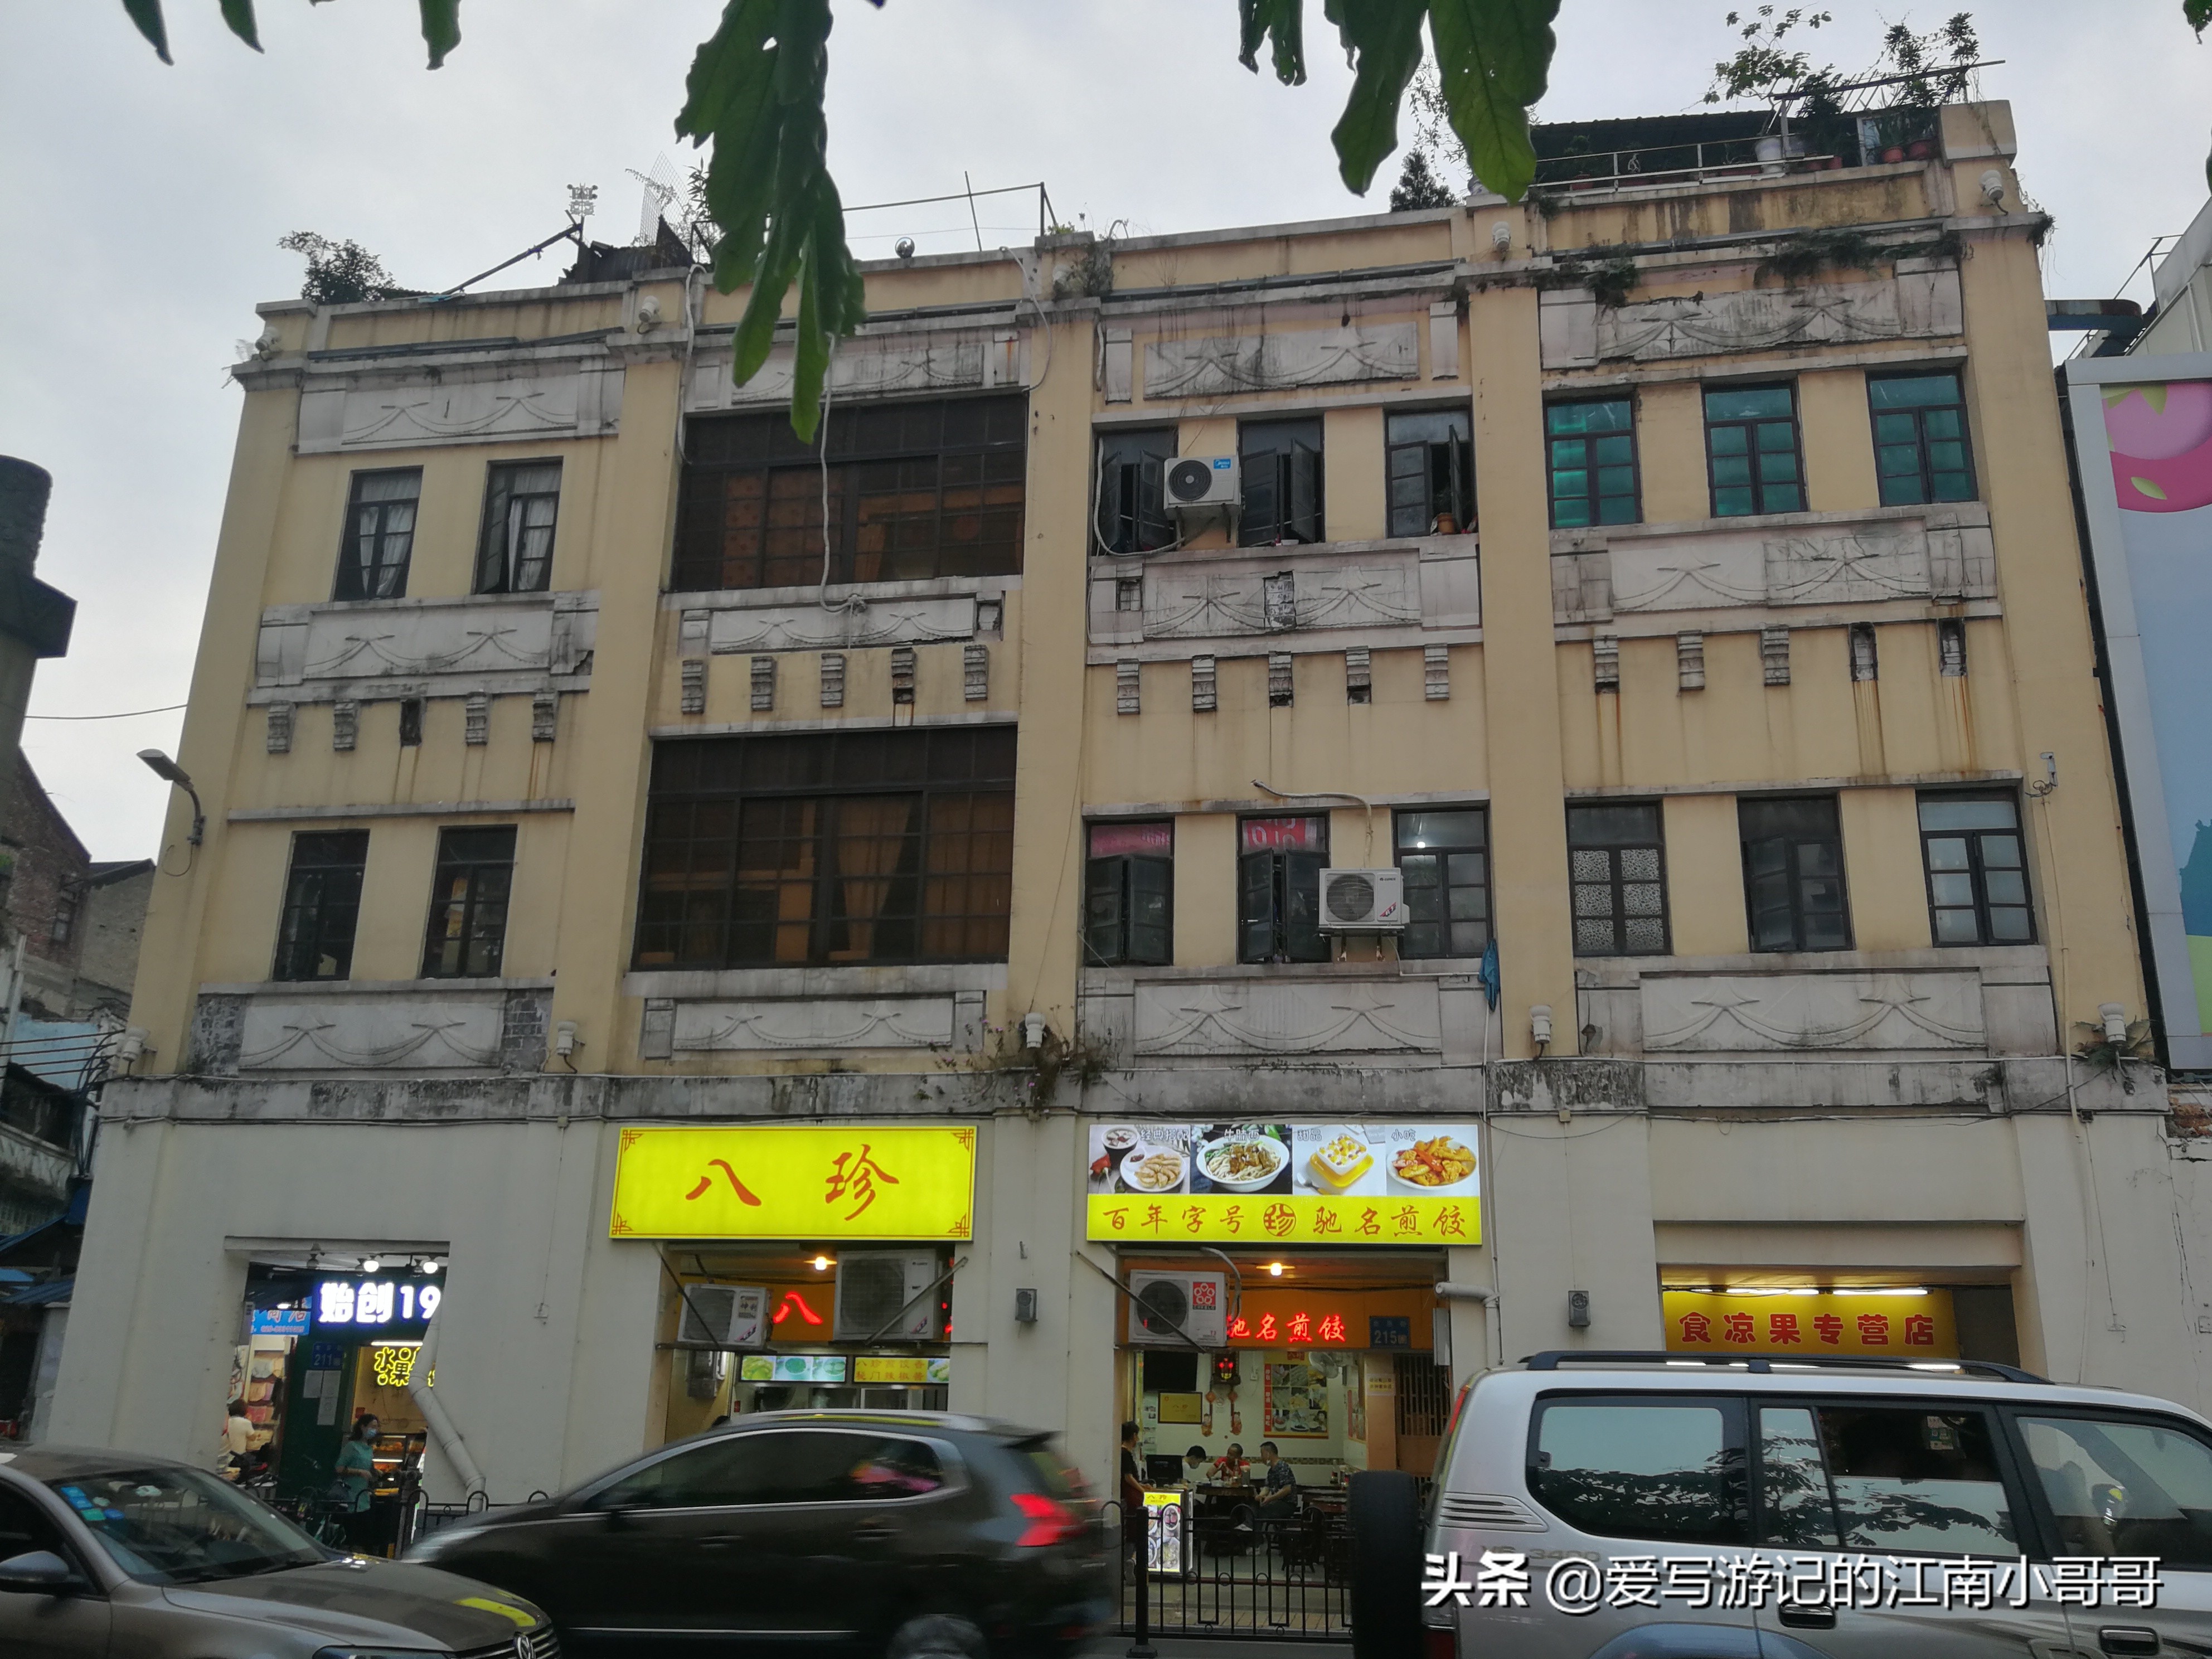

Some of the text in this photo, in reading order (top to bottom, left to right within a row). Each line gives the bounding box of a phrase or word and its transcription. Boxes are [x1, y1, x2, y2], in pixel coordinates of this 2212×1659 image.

[1141, 1128, 1190, 1142] 经典搭配
[1297, 1128, 1322, 1142] 甜品
[1390, 1128, 1416, 1142] 小吃
[685, 1144, 900, 1221] 八珍
[1103, 1202, 1245, 1235] 百年字号
[1313, 1205, 1467, 1238] 驰名煎饺
[773, 1291, 823, 1325] 八
[1679, 1311, 1935, 1346] 食凉果专营店
